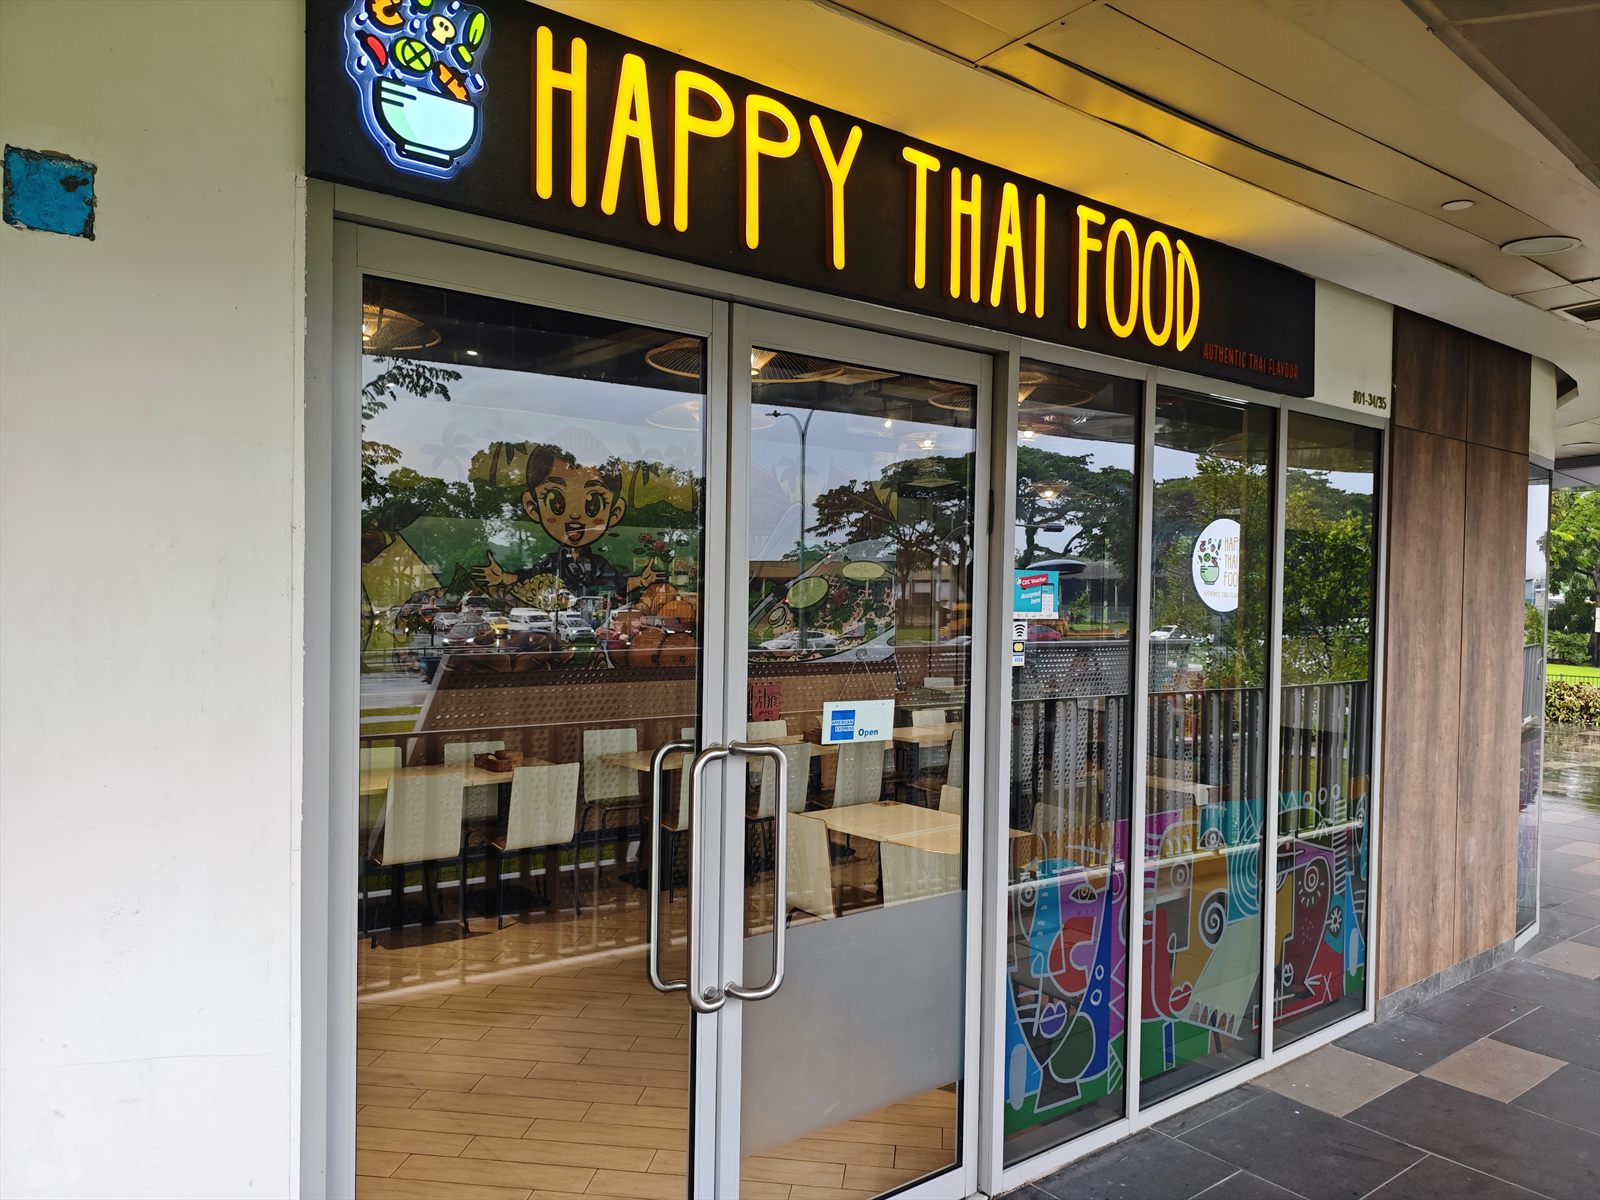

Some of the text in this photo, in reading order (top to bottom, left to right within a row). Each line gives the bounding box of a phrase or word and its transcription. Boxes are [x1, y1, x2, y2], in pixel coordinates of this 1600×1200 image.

[534, 25, 1200, 352] HAPPY THAI FOOD
[1202, 342, 1299, 380] AUTHENTIC THAI FLAVOUR
[1352, 390, 1387, 410] #01-34/35
[1224, 536, 1239, 552] HAP
[1021, 578, 1031, 586] CDC
[1224, 571, 1238, 587] FOO
[858, 728, 879, 738] Open
